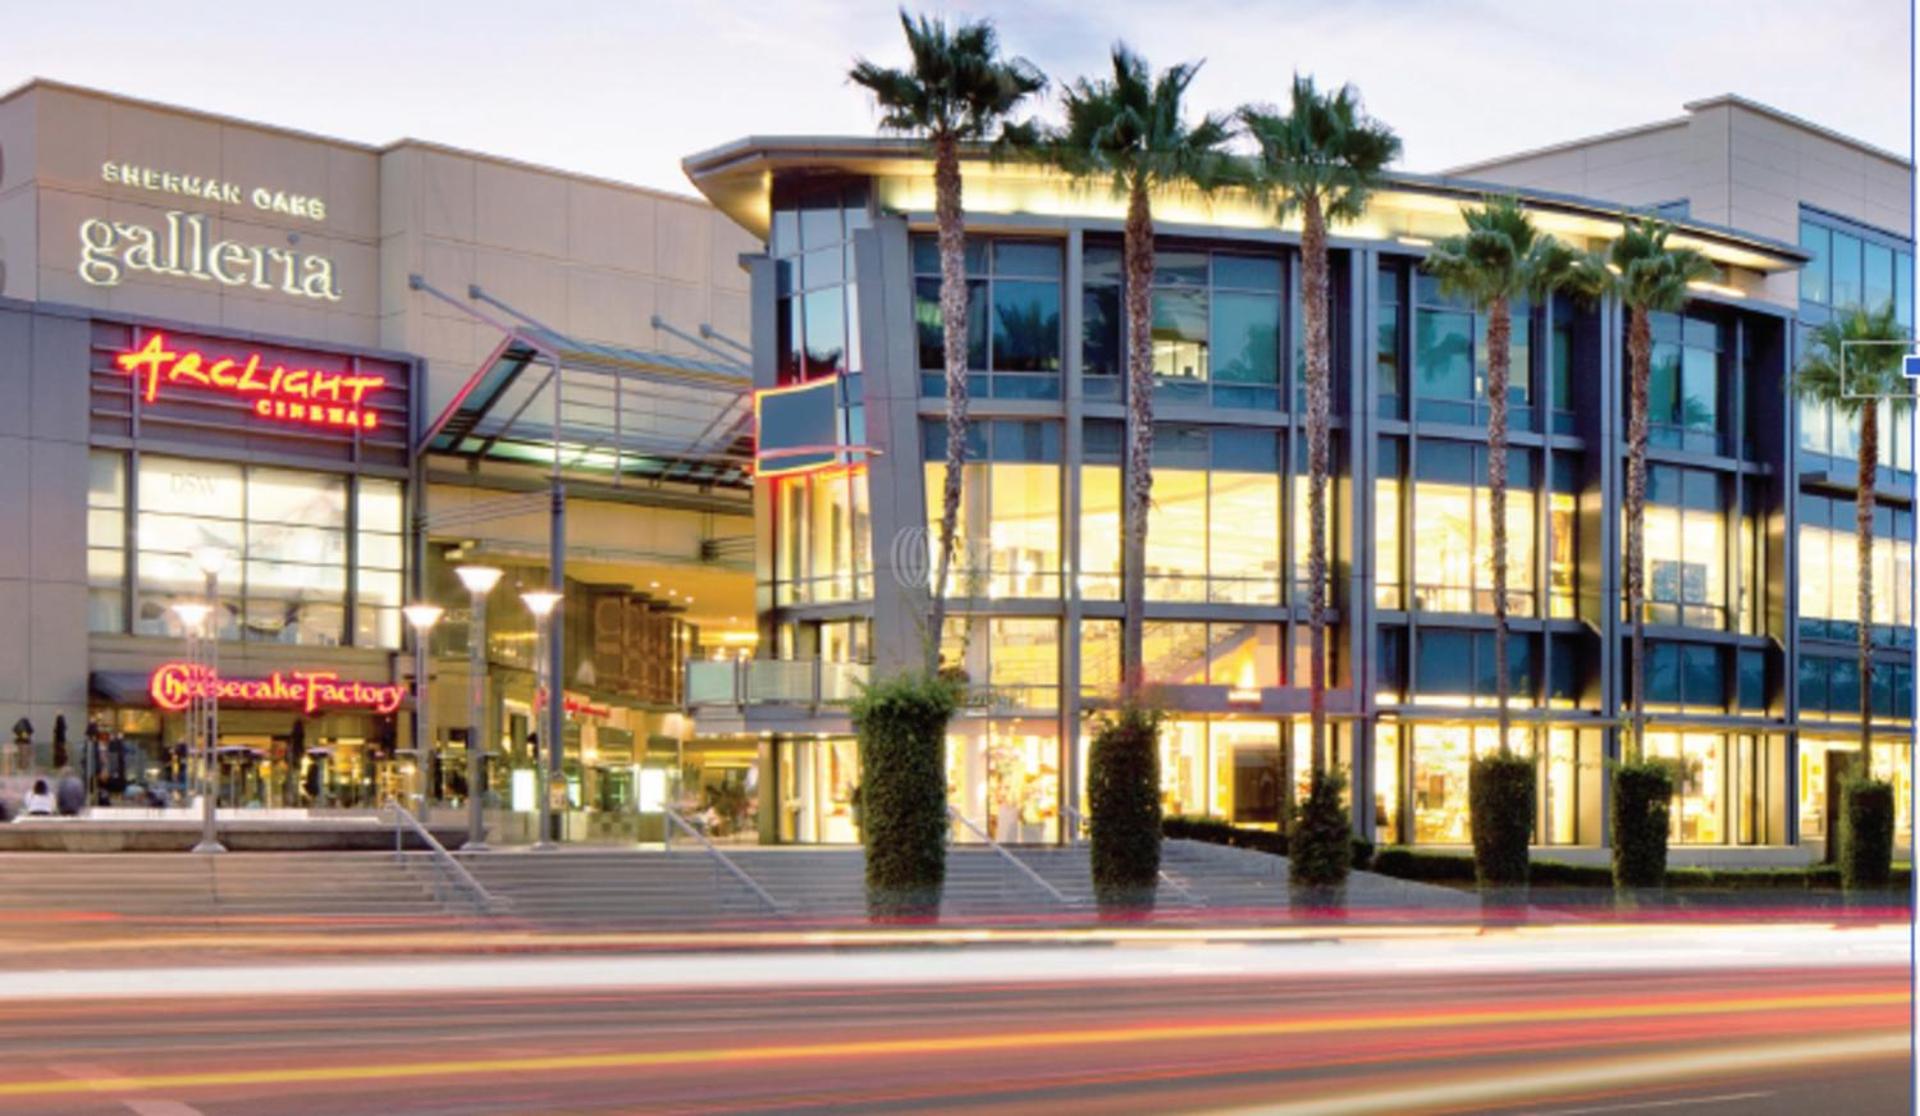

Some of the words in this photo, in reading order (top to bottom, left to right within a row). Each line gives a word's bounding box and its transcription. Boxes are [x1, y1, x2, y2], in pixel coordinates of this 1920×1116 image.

[102, 161, 241, 204] SHERMAN
[252, 187, 326, 220] OAKS
[79, 211, 341, 301] galleria
[257, 400, 377, 428] CINEMAS
[294, 669, 407, 714] Factory
